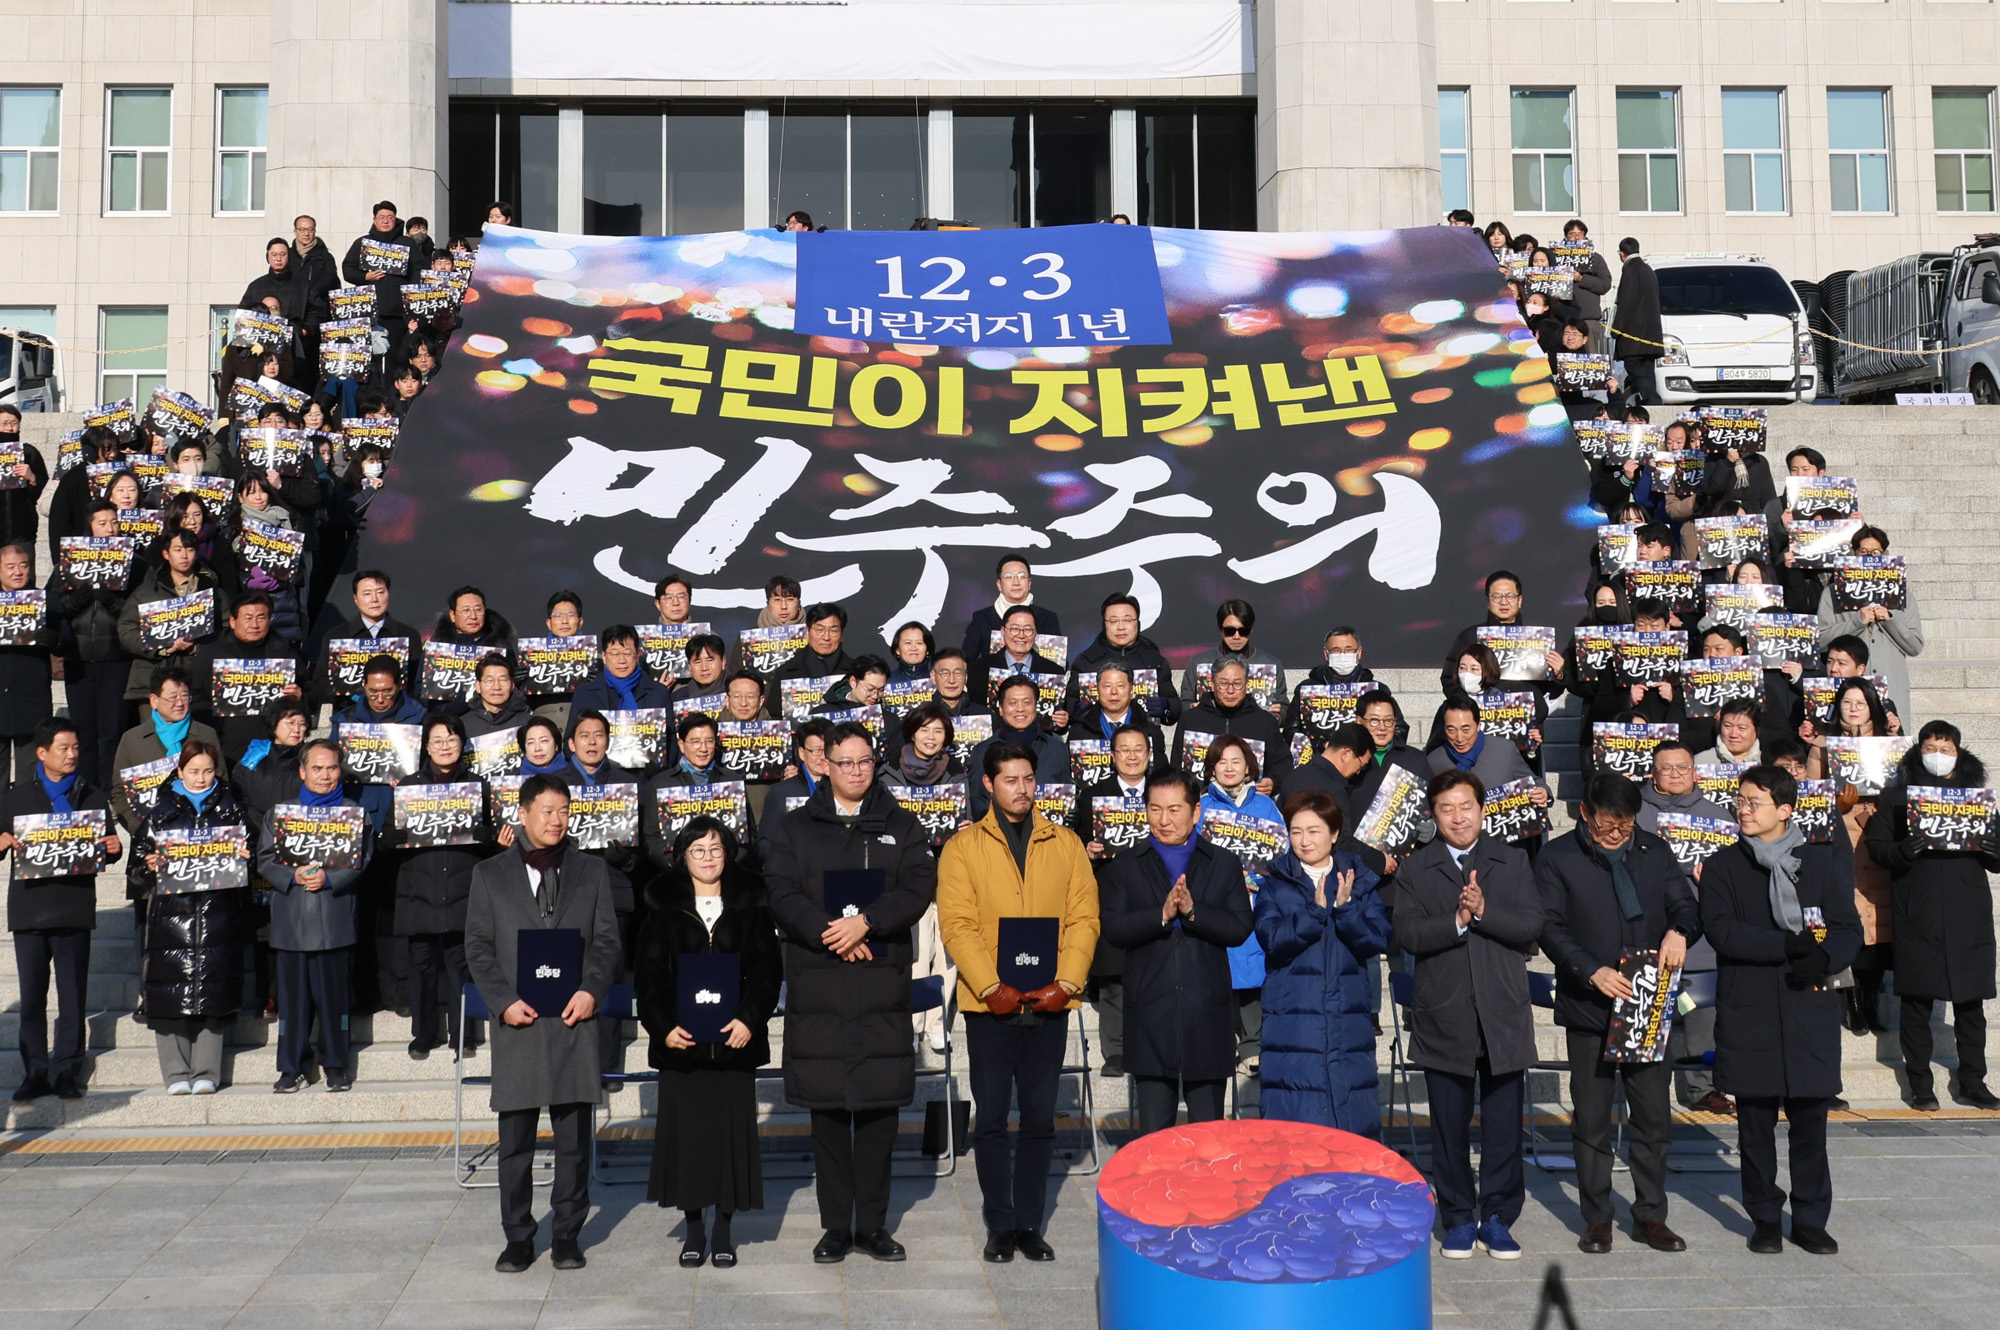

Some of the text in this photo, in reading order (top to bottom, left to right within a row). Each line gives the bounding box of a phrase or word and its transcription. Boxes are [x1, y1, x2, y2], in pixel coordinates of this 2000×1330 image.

[824, 306, 1131, 343] 내란저지 1년
[588, 338, 1399, 437] 국민이 지켜낸
[91, 409, 130, 426] 국민이 지켜낸
[158, 400, 204, 426] 국민이 지켜낸
[152, 410, 201, 441] 민주주의
[1710, 419, 1759, 428] 국민이 지켜낸
[350, 428, 391, 437] 국민이 지켜낸
[1708, 428, 1759, 446] 민주주의
[134, 465, 158, 476] 국민이
[198, 490, 224, 500] 지켜낸
[1796, 490, 1849, 501] 국민이 지켜낸
[131, 521, 158, 532] 지켜낸
[1707, 527, 1759, 540] 국민이 지켜낸
[248, 533, 293, 554] 국민이 지켜낸
[528, 436, 1441, 647] 민주주의
[1708, 539, 1761, 560] 민주주의
[72, 551, 125, 563] 국민이 지켜낸
[245, 545, 293, 570] 민주주의
[70, 562, 124, 583] 민주주의
[1845, 568, 1897, 579] 국민이 지켜낸
[1636, 574, 1691, 585] 국민이 지켜낸
[1635, 585, 1692, 606] 민주주의
[1843, 579, 1898, 602] 민주주의
[4, 604, 33, 615] 지켜낸
[1717, 598, 1744, 608] 국민이
[151, 603, 205, 622] 국민이 지켜낸
[151, 616, 207, 638] 민주주의
[1758, 628, 1810, 639] 국민이 지켜낸
[647, 638, 673, 650] 국민이
[753, 640, 780, 653] 국민이
[1757, 639, 1812, 662] 민주주의
[530, 649, 587, 662] 국민이 지켜낸
[1625, 645, 1679, 657] 국민이 지켜낸
[340, 652, 368, 664] 국민이
[435, 658, 464, 670] 국민이
[529, 662, 589, 685] 민주주의
[1624, 657, 1680, 680] 민주주의
[225, 673, 286, 684] 국민이 지켜낸
[1694, 670, 1754, 685] 국민이 지켜낸
[792, 691, 819, 704] 국민이
[907, 690, 933, 703] 지켜낸
[1694, 684, 1756, 708] 민주주의
[1312, 697, 1340, 709] 국민이
[1497, 706, 1525, 718] 지켜낸
[723, 735, 781, 748] 국민이 지켜낸
[1605, 738, 1635, 749] 국민이
[722, 748, 782, 772] 민주주의
[1082, 753, 1111, 766] 국민이
[1698, 778, 1726, 790] 국민이
[407, 797, 471, 812] 국민이 지켜낸
[597, 799, 627, 813] 지켜낸
[671, 797, 735, 815] 국민이 지켜낸
[925, 799, 954, 812] 지켜낸
[1035, 799, 1064, 811] 지켜낸
[1499, 794, 1530, 811] 지켜낸
[1797, 795, 1825, 808] 지켜낸
[1373, 781, 1410, 837] 국민이 지켜낸
[1920, 803, 1984, 818] 국민이 지켜낸
[1105, 811, 1134, 824] 국민이
[1384, 788, 1427, 848] 민주주의
[288, 821, 352, 834] 국민이 지켜낸
[406, 811, 473, 838] 민주주의
[1919, 816, 1984, 842] 민주주의
[27, 826, 94, 843] 국민이 지켜낸
[1213, 824, 1277, 845] 국민이 지켜낸
[1670, 828, 1702, 841] 국민이
[169, 841, 235, 857] 국민이 지켜낸
[286, 833, 353, 859] 민주주의
[25, 841, 95, 868] 민주주의
[168, 856, 237, 883] 민주주의
[1015, 954, 1040, 965] 민주당
[535, 966, 561, 978] 민주당
